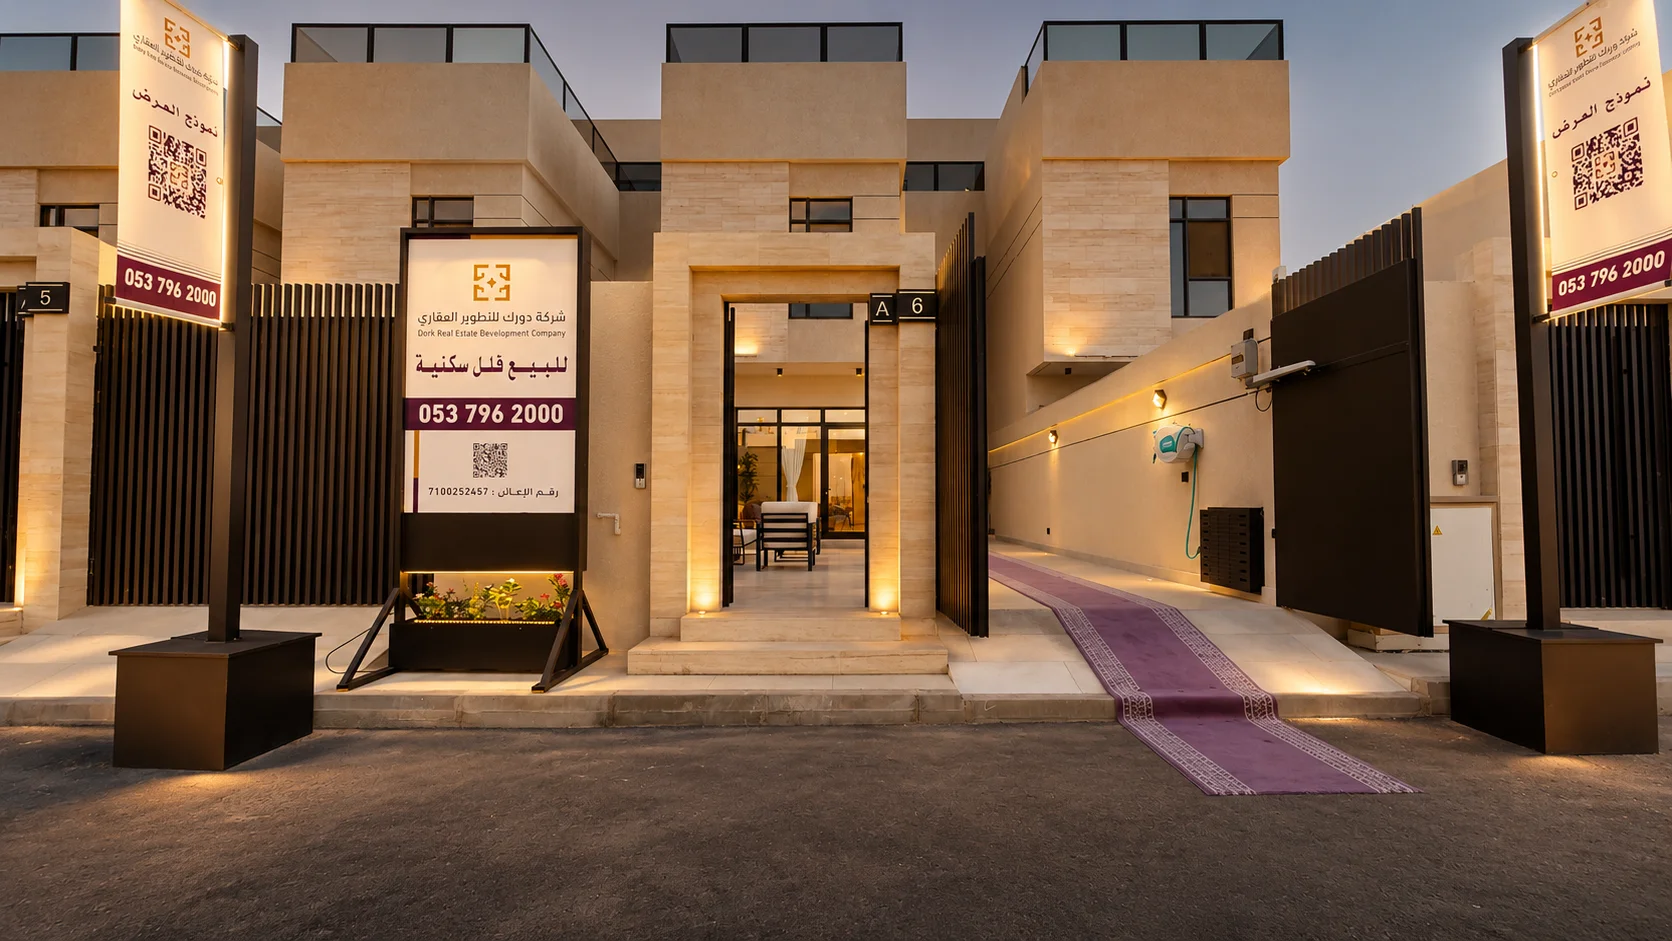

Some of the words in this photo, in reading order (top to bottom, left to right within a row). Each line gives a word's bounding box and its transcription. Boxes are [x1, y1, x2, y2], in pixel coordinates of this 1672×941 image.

[1558, 274, 1586, 296] 053
[1590, 265, 1618, 288] 796
[1622, 250, 1665, 278] 2000
[124, 267, 153, 291] 053
[157, 276, 182, 298] 796
[185, 284, 217, 307] 2000
[40, 289, 51, 306] 5
[911, 297, 924, 314] 6
[535, 309, 566, 325] شركة
[875, 300, 890, 317] A
[417, 311, 458, 327] العقاري
[502, 311, 533, 326] دورك
[417, 329, 436, 338] Dork
[437, 329, 454, 338] Real
[455, 329, 478, 338] Estate
[531, 329, 567, 339] Company
[415, 353, 469, 379] سكنية
[418, 403, 458, 424] 053
[465, 403, 504, 424] 796
[510, 403, 564, 424] 2000
[428, 487, 489, 496] 7100252457
[535, 487, 559, 498] رقم
